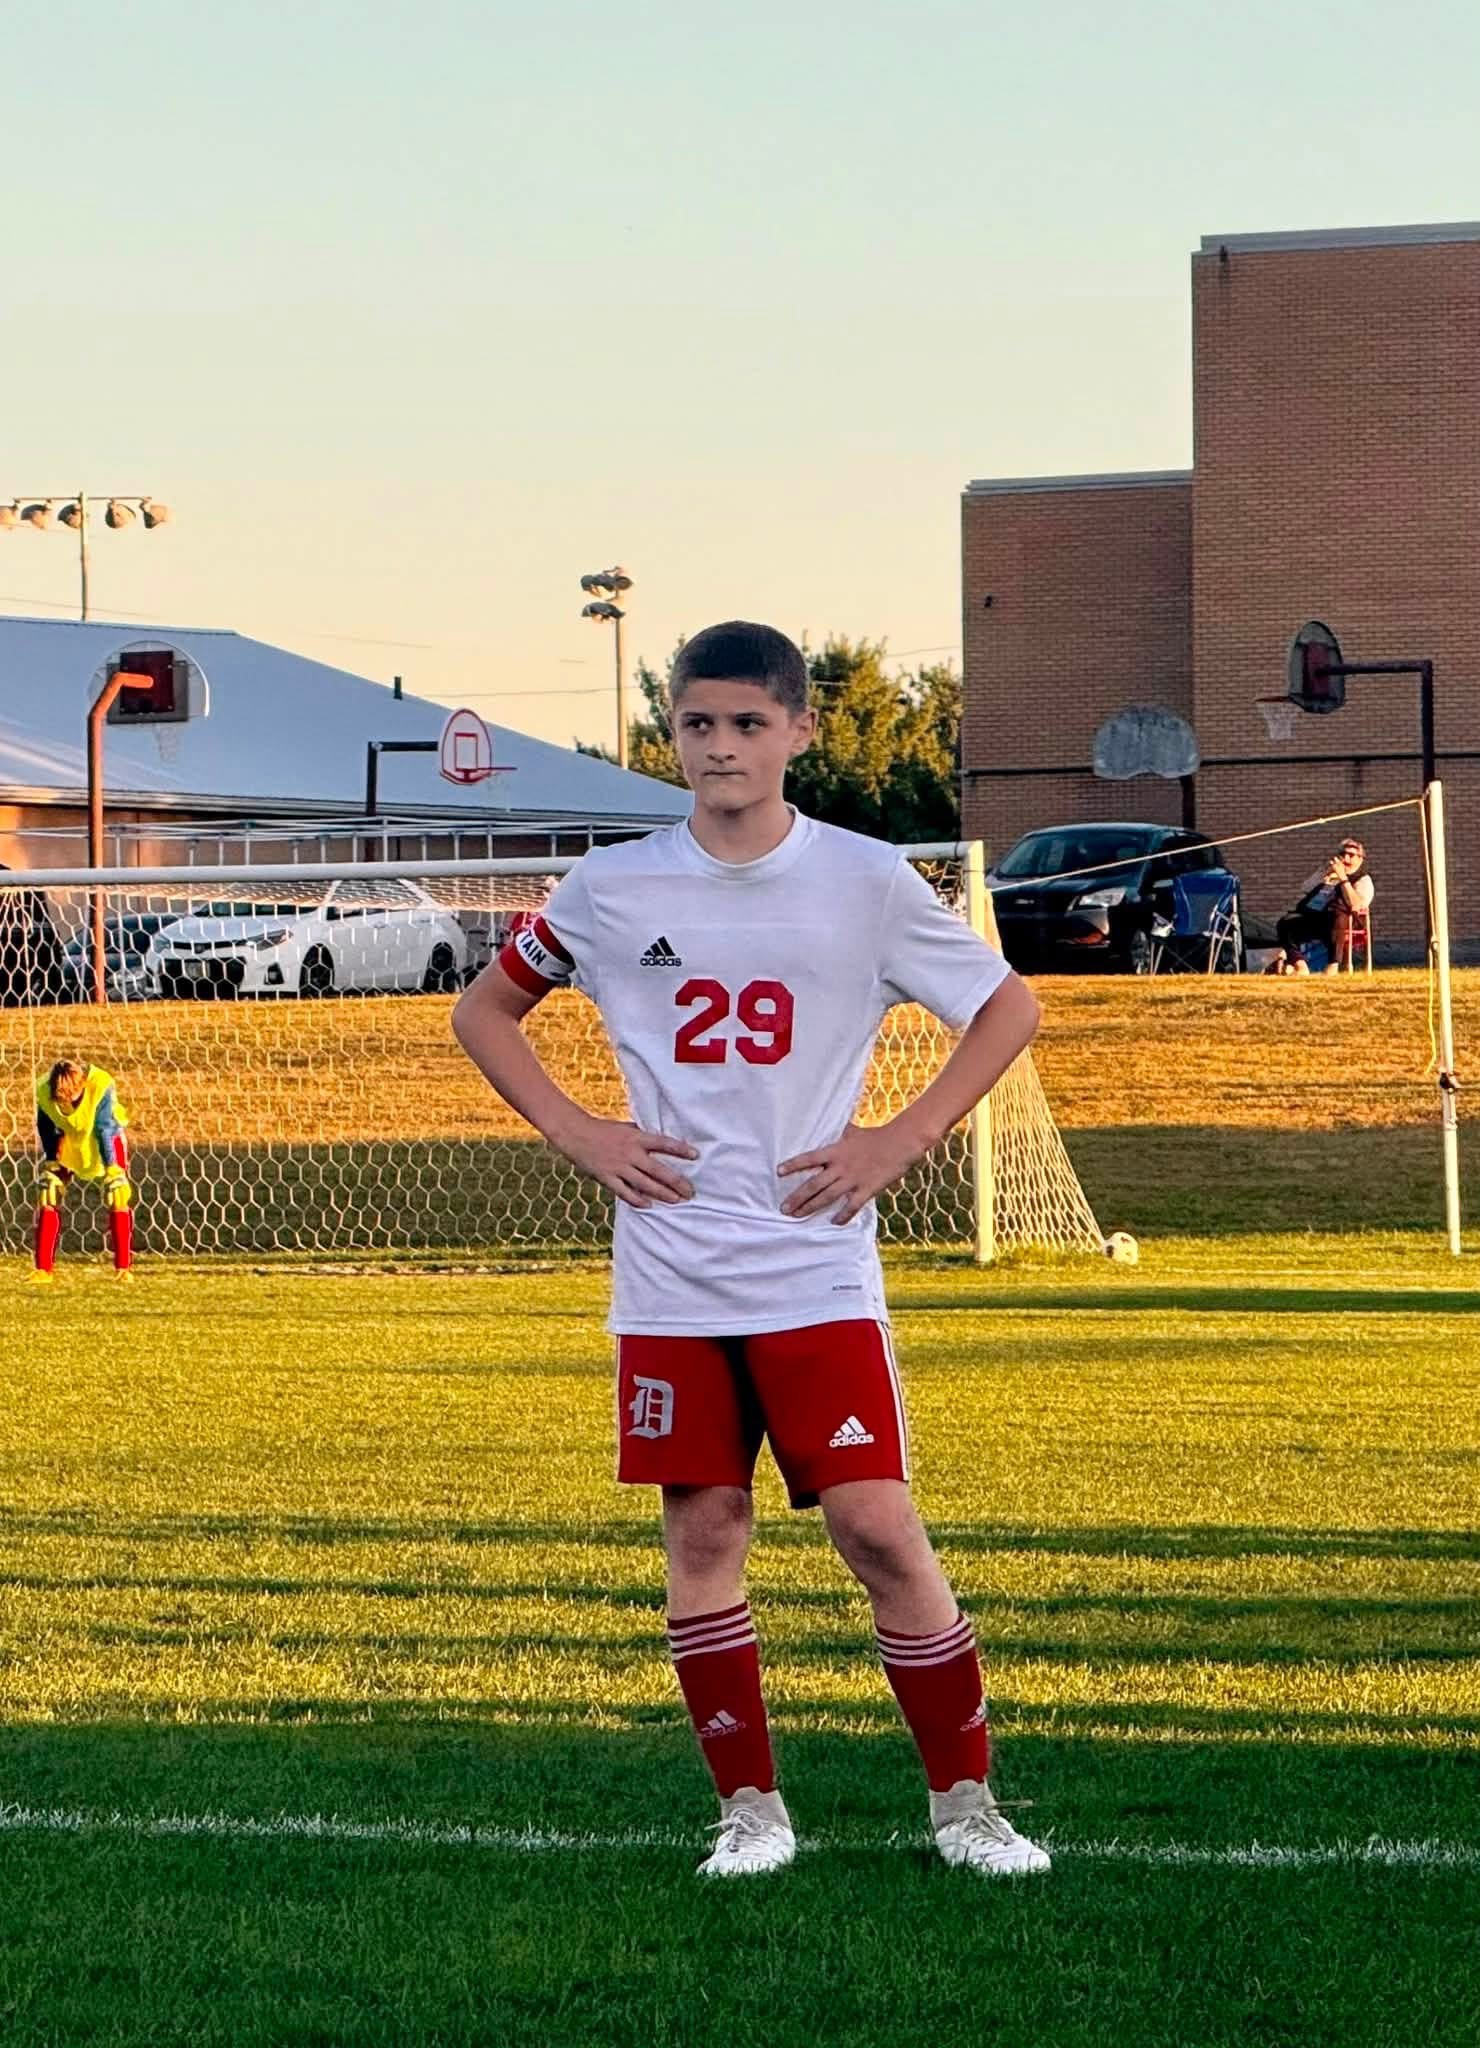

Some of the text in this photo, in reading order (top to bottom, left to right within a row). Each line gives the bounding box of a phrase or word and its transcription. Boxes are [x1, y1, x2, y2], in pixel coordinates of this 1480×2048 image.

[640, 956, 682, 967] adidas
[674, 978, 794, 1065] 29
[626, 1374, 674, 1439] D
[829, 1433, 875, 1448] adidas
